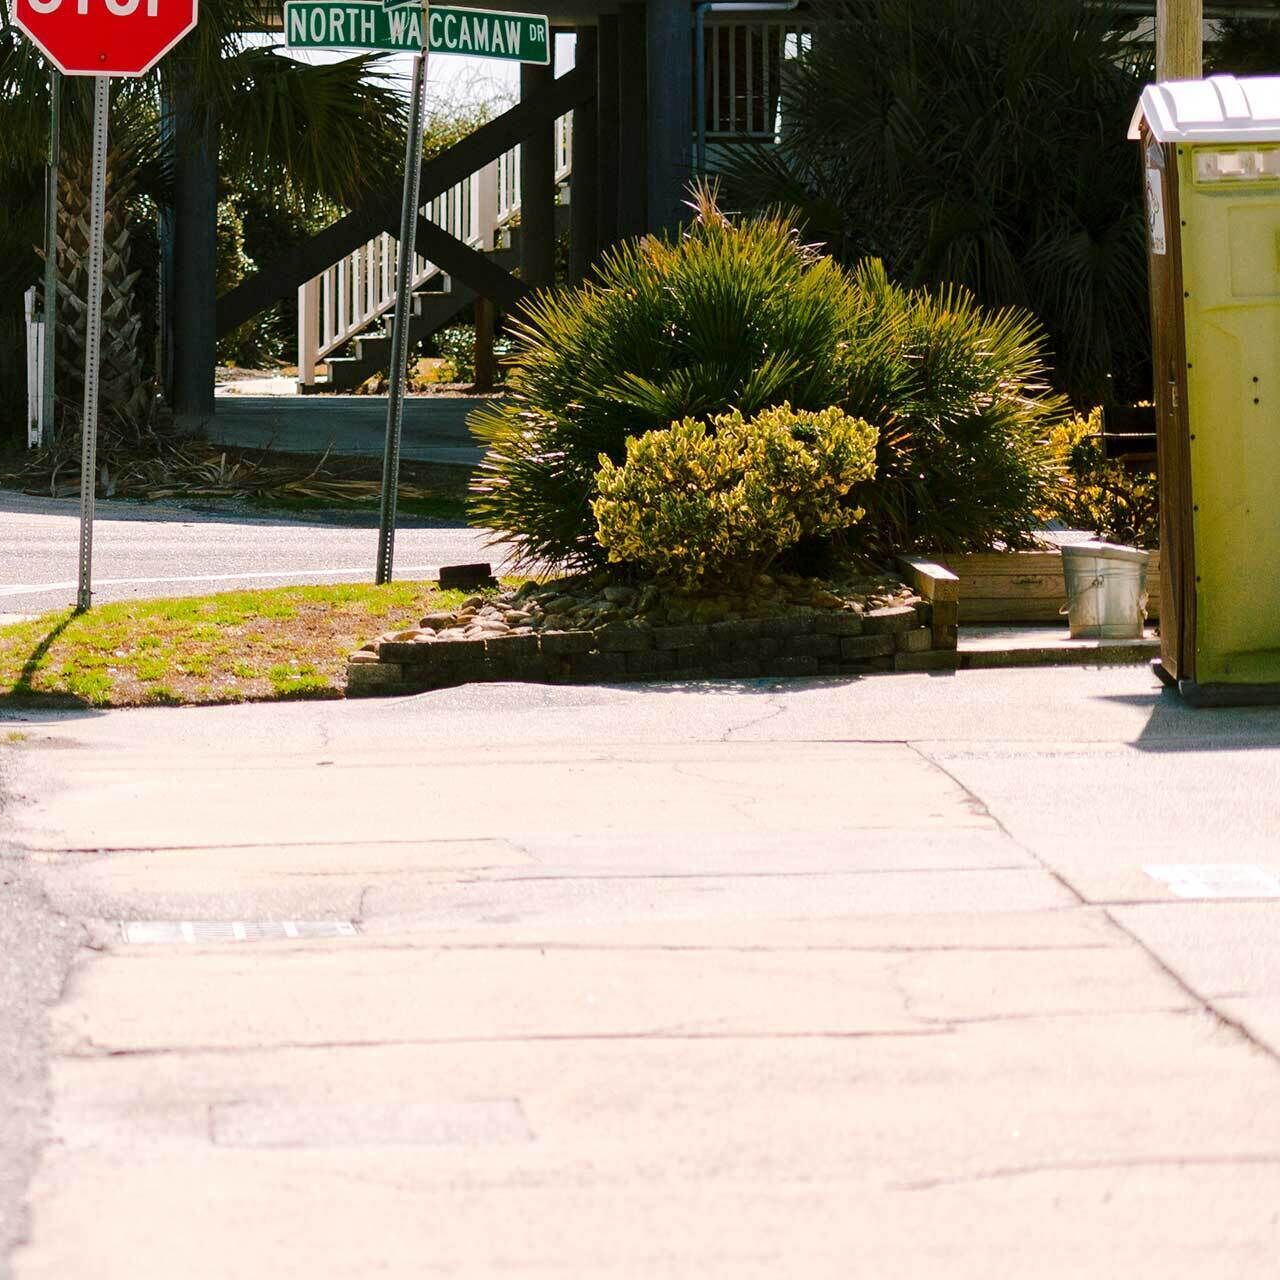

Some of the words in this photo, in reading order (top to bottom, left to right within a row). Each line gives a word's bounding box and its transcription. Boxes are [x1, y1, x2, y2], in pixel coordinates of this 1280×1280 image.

[290, 7, 376, 44] NORTH
[388, 10, 522, 56] WACCAMAW
[529, 22, 546, 43] DR
